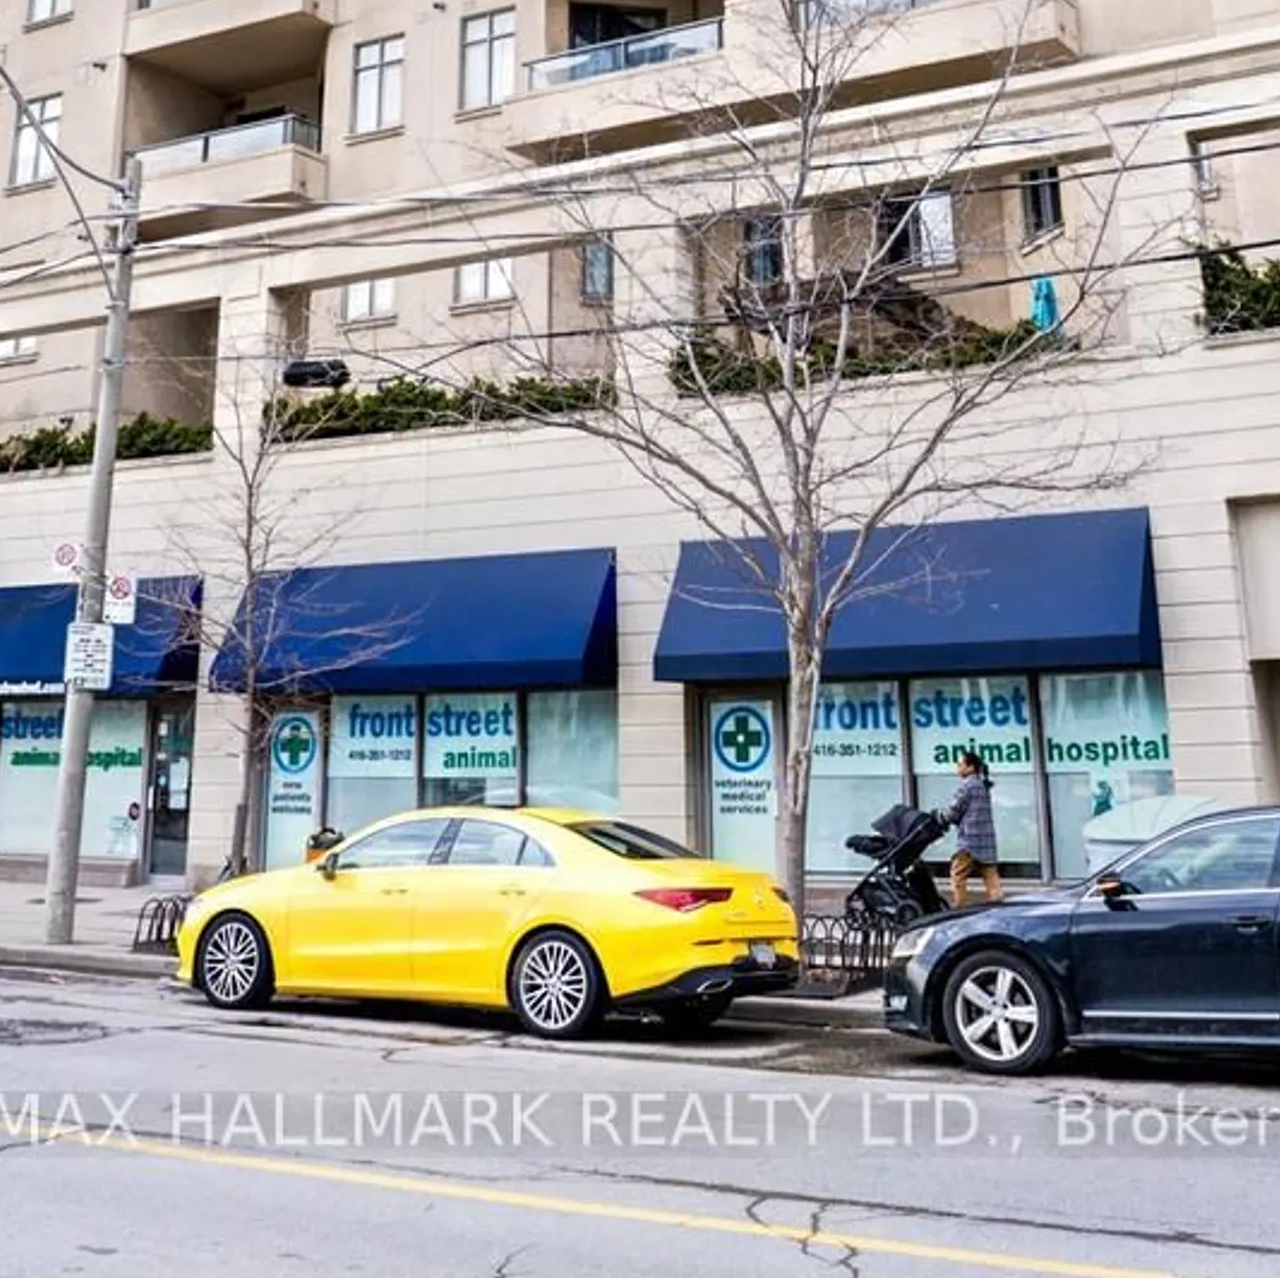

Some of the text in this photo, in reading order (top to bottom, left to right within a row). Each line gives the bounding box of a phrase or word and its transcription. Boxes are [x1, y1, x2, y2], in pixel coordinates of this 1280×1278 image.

[913, 687, 1028, 728] street
[349, 702, 514, 738] front street
[11, 747, 142, 771] anima ospital
[443, 746, 517, 769] animal
[933, 734, 1170, 766] animal hospital
[715, 778, 771, 791] veterinary
[722, 791, 766, 802] medical
[720, 805, 768, 815] services
